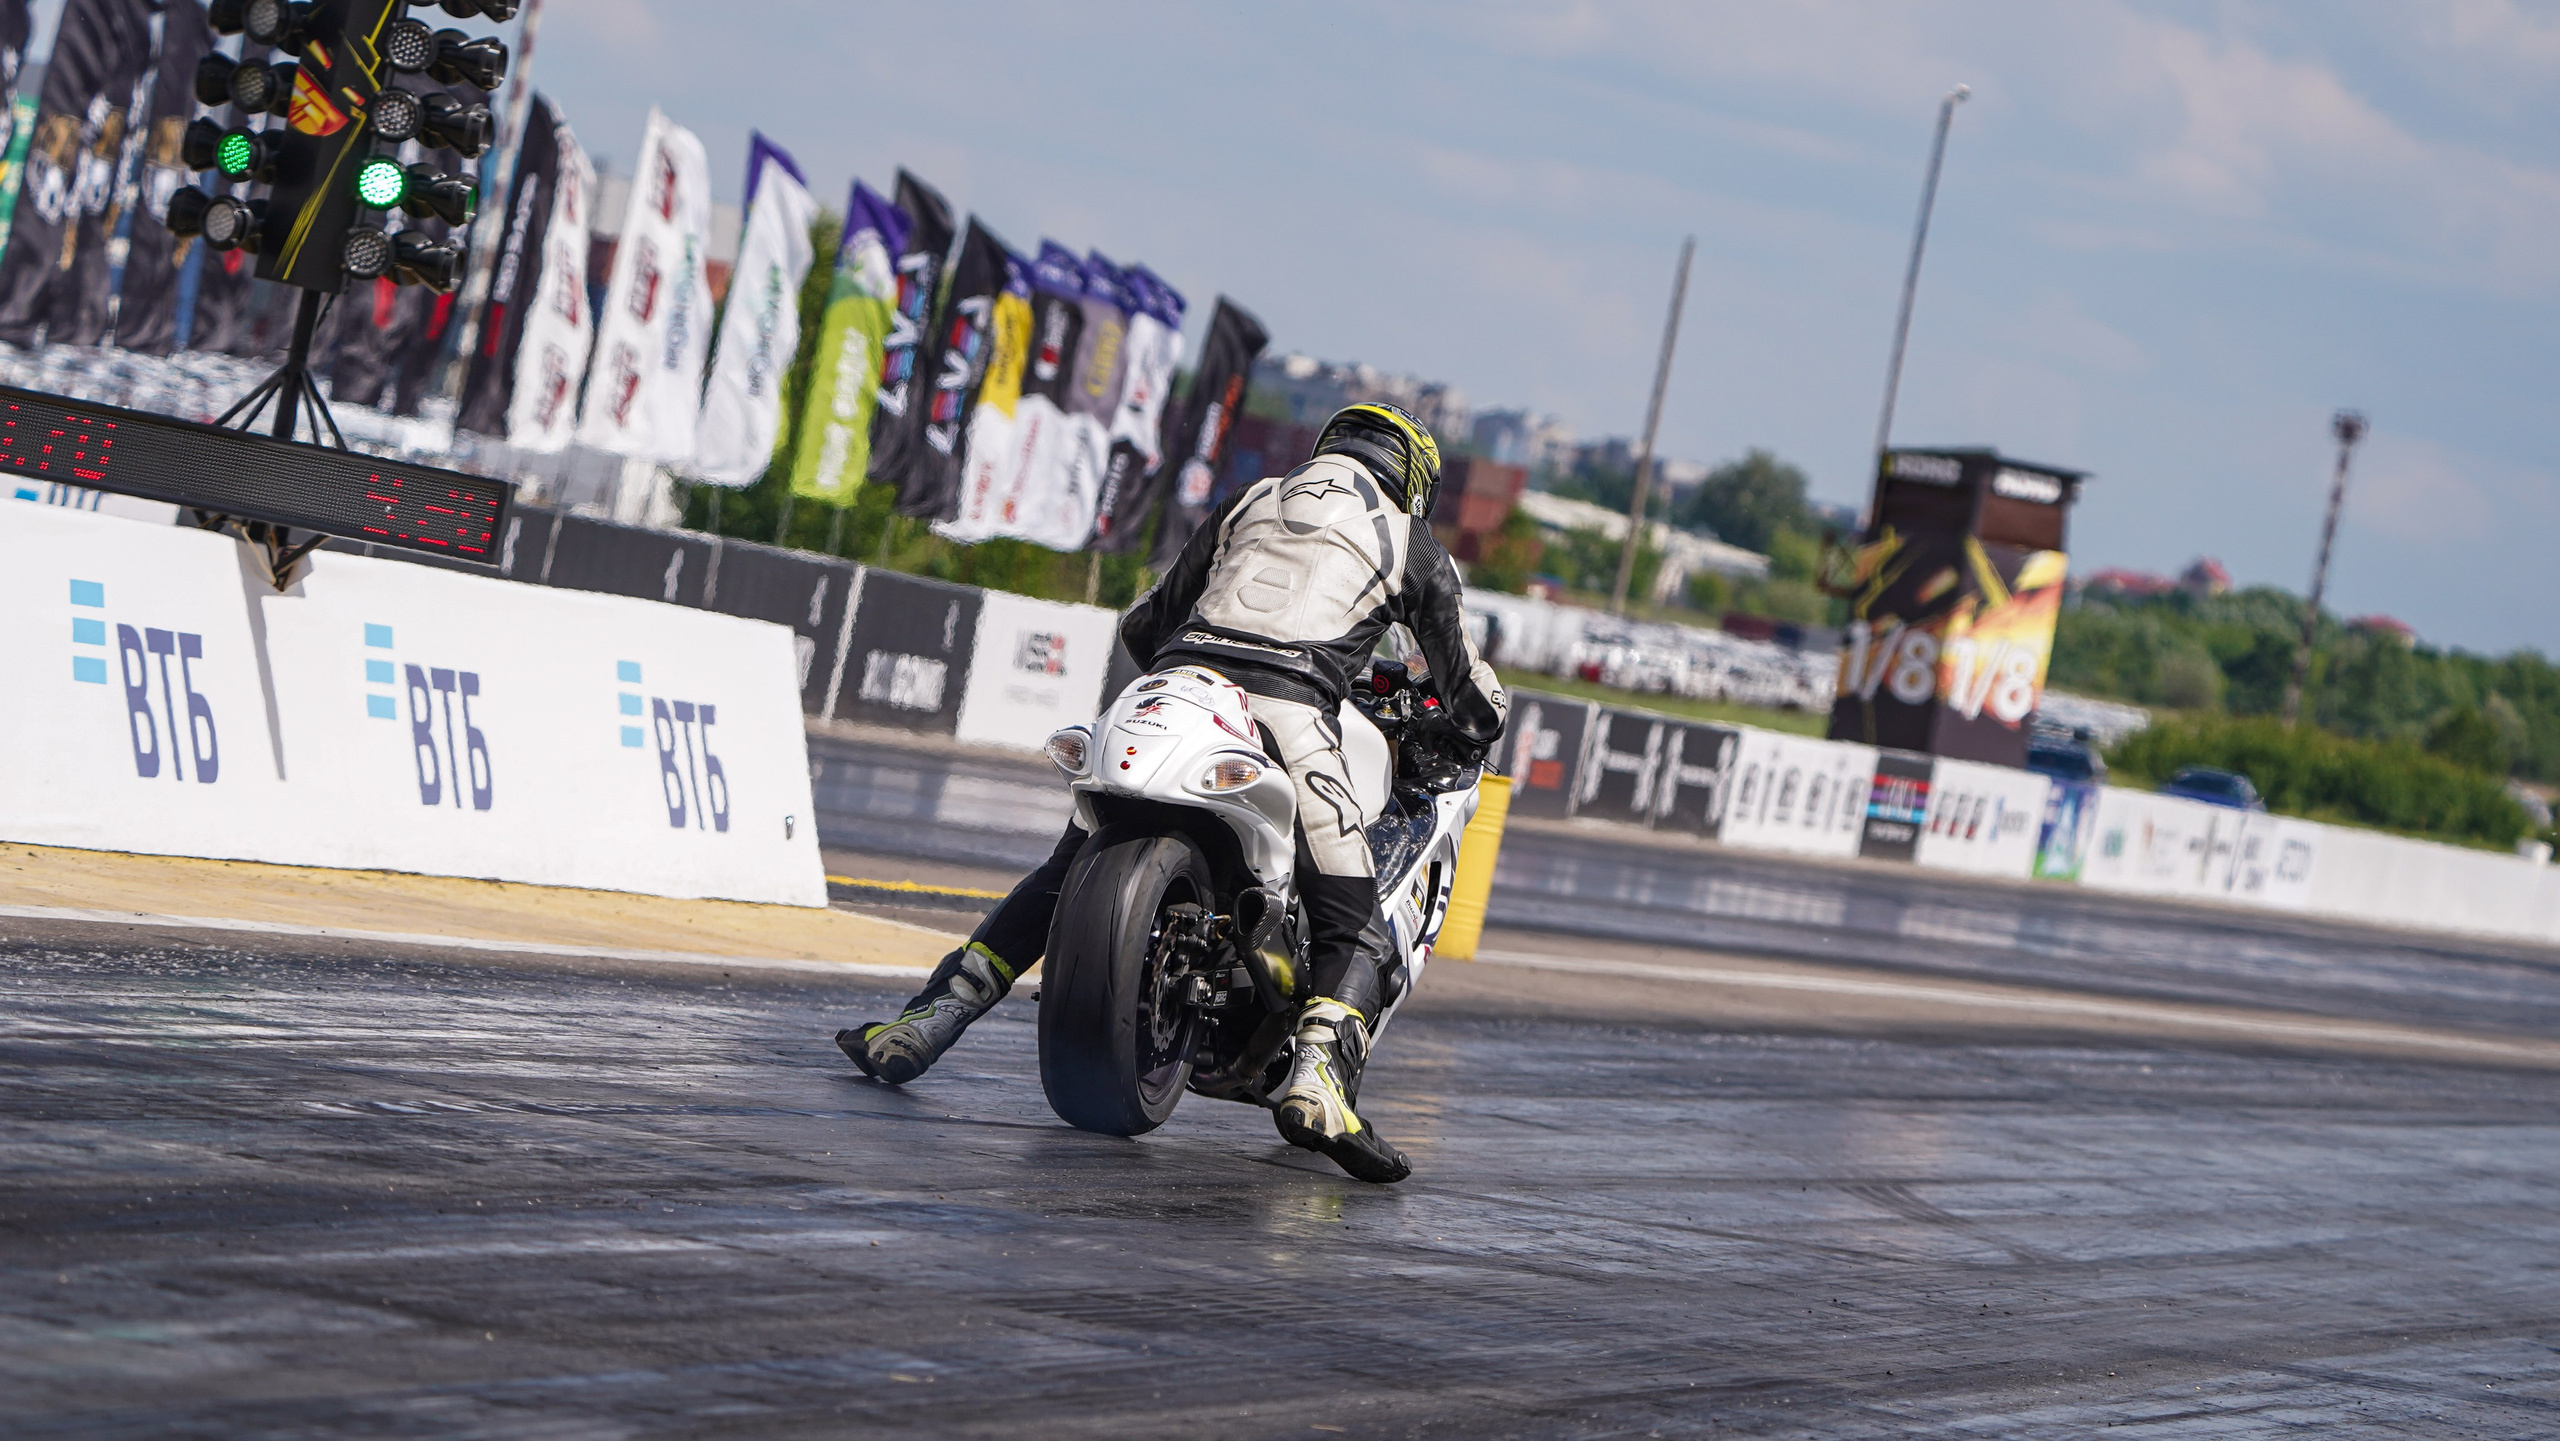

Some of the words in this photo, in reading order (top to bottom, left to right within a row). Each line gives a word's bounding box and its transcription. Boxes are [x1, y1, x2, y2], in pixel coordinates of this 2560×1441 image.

[116, 623, 219, 784] ВТБ
[1845, 618, 1941, 706] 1/8
[1947, 636, 2038, 722] 1/8
[404, 663, 493, 811] ВТБ
[651, 696, 730, 833] ВТБ
[1125, 718, 1168, 731] SUZUKI
